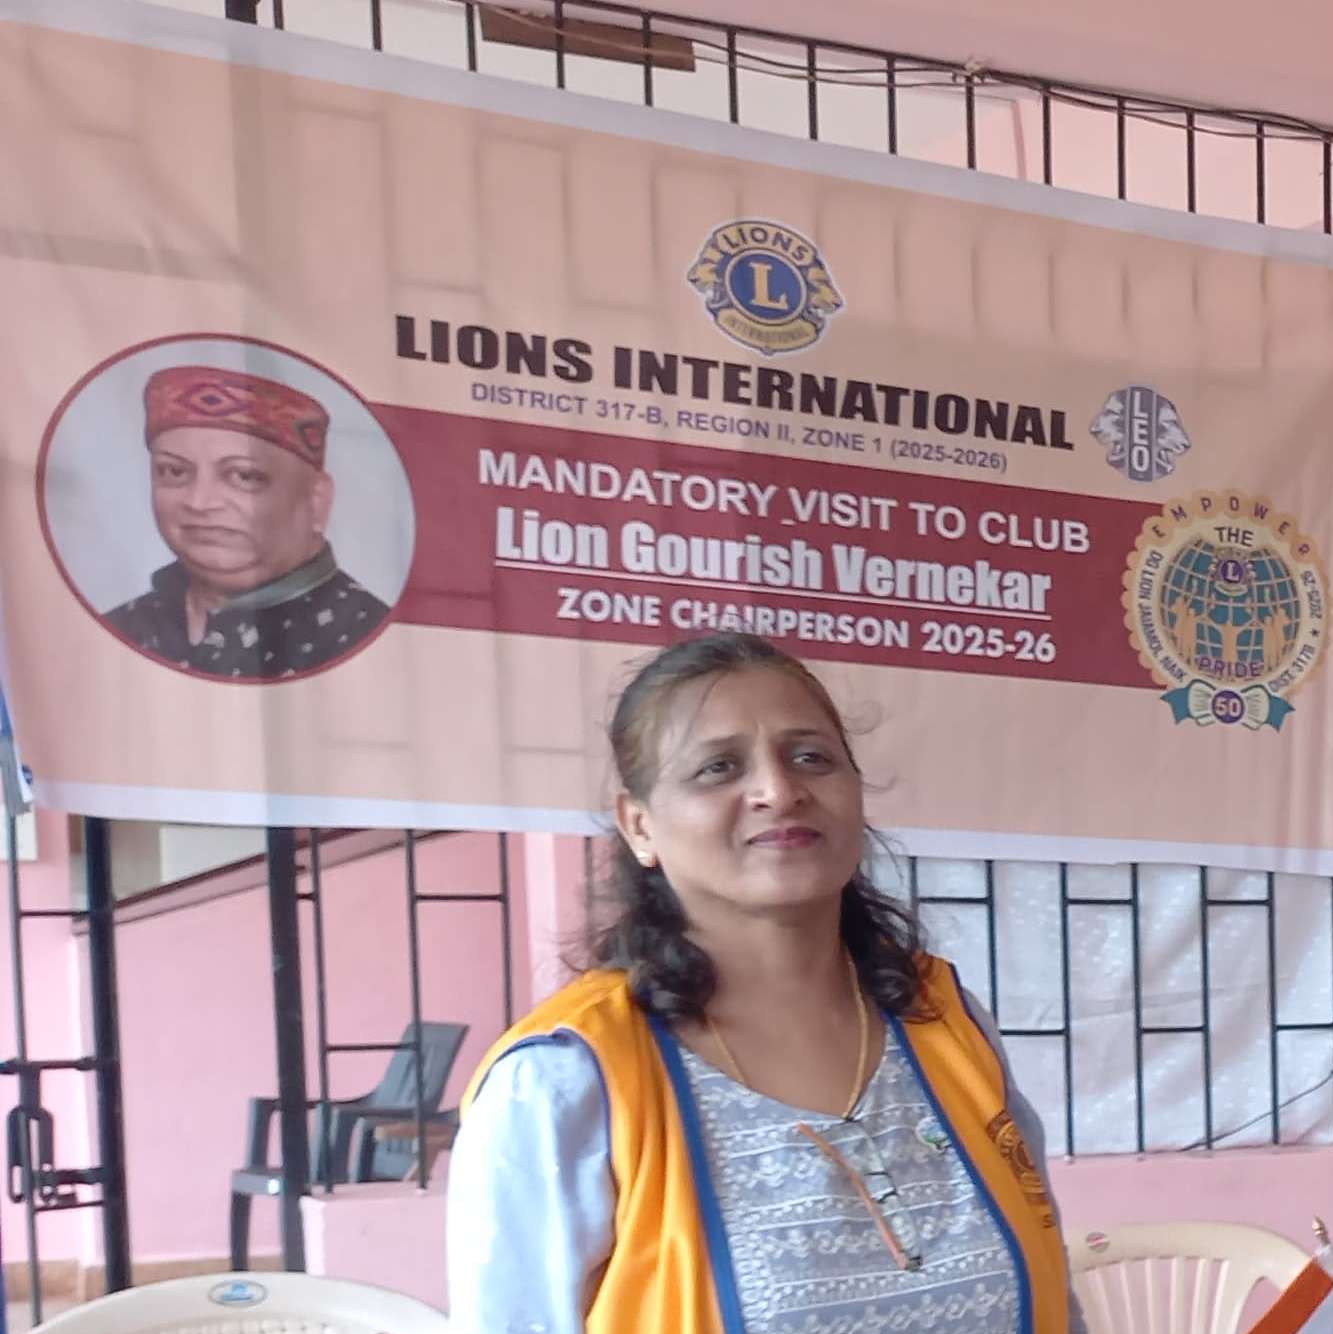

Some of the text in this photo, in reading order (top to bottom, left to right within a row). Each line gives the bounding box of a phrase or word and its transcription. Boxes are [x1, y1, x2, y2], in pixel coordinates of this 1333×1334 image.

[722, 226, 809, 261] LIONS
[749, 261, 789, 310] L
[396, 314, 1075, 451] LIONS INTERNATIONAL
[471, 383, 588, 414] DISTRICT
[596, 400, 669, 428] 317-B,
[677, 410, 770, 440] REGION
[802, 427, 865, 452] ZONE
[872, 437, 882, 453] 1
[890, 438, 1008, 474] (2025-2026)
[1132, 391, 1150, 472] LEO
[478, 448, 1091, 554] MANDATORY VISIT TO CLUB
[1151, 497, 1311, 556] EMPOWER
[496, 506, 1052, 613] Lion Gourish Vernekar
[1214, 526, 1255, 547] THE
[1226, 563, 1241, 582] L
[556, 587, 1058, 664] ZONE CHAIRPERSON 2025-26
[1197, 656, 1262, 678] PRIDE
[1213, 699, 1242, 714] 50
